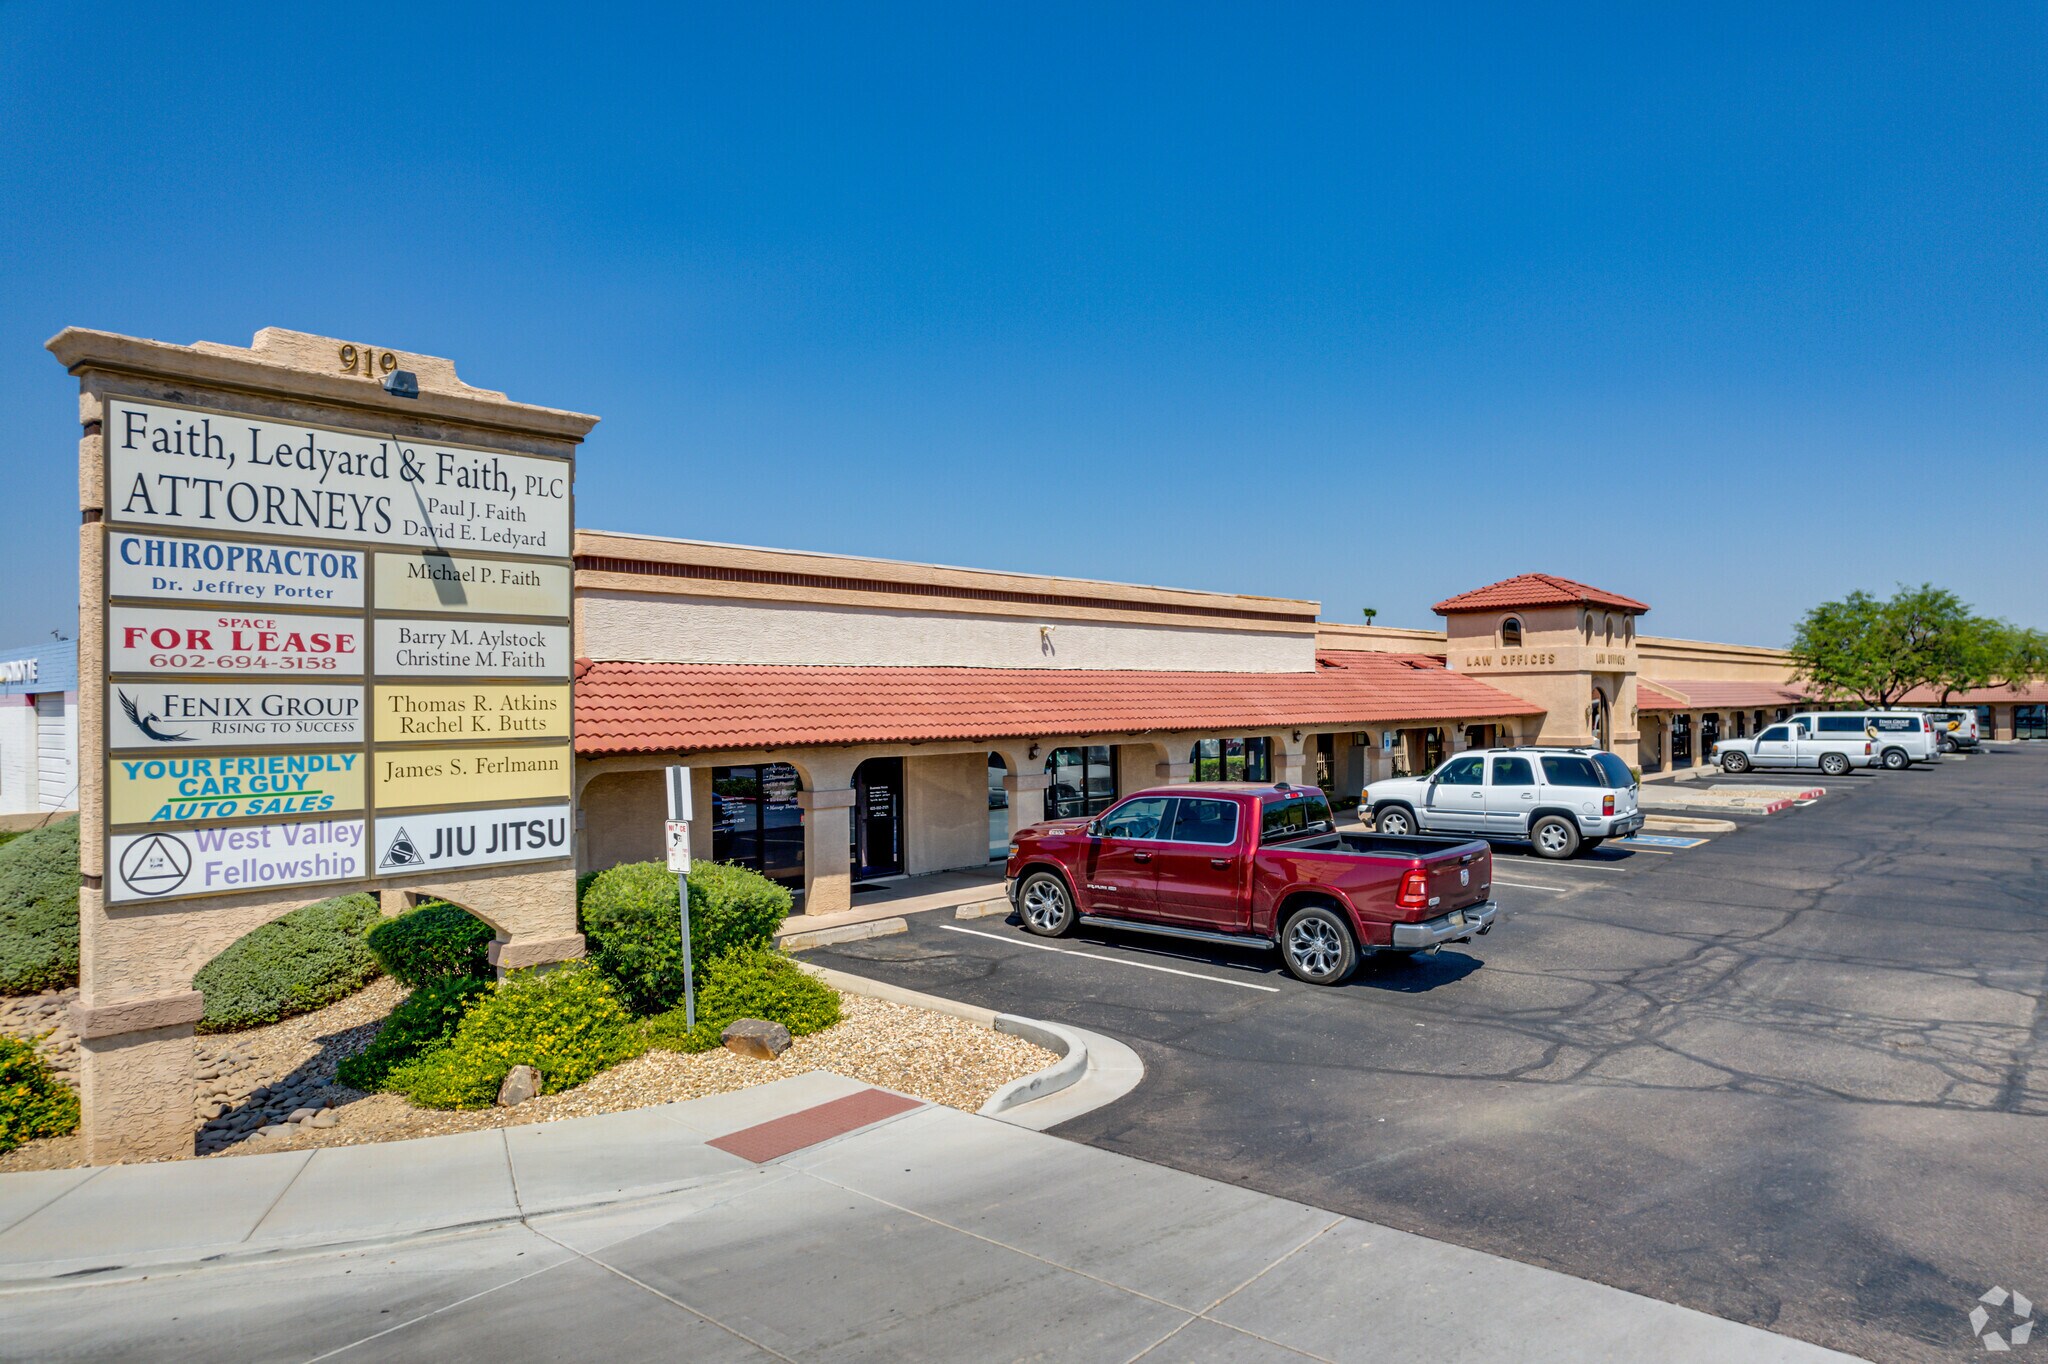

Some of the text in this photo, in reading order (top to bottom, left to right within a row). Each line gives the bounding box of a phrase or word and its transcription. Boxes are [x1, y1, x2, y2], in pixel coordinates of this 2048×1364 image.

[338, 344, 397, 378] 919
[121, 410, 564, 501] Faith, Ledyard & Faith, PLC
[121, 472, 392, 535] ATTORNEYS
[428, 497, 527, 523] Paul J. Faith
[402, 519, 547, 549] David E. Ledyard
[120, 537, 359, 580] CHIROPRACTOR
[151, 576, 335, 599] Dr. Jeffrey Porter
[407, 562, 541, 587] Michael P. Faith
[217, 617, 277, 630] SPACE
[122, 626, 357, 654] FOR LEASE
[398, 627, 548, 651] Barry M. Aylstock
[149, 653, 337, 670] 602-694-3158
[396, 649, 547, 668] Christine M. Faith
[1466, 653, 1556, 667] LAW OFFICES
[162, 694, 360, 718] FENIX GROUP
[387, 694, 558, 713] Thomas R. Atkins
[211, 720, 355, 734] RISING TO SUCCESS
[399, 714, 548, 734] Rachel K. Butts
[121, 753, 358, 780] YOUR FRIENDLY
[383, 755, 560, 783] James S. Ferlmann
[178, 773, 310, 797] CAR GUY
[150, 794, 336, 822] AUTO SALES
[194, 820, 364, 853] West Valley
[429, 817, 566, 860] JIU JITSU
[204, 851, 356, 887] Fellowship
